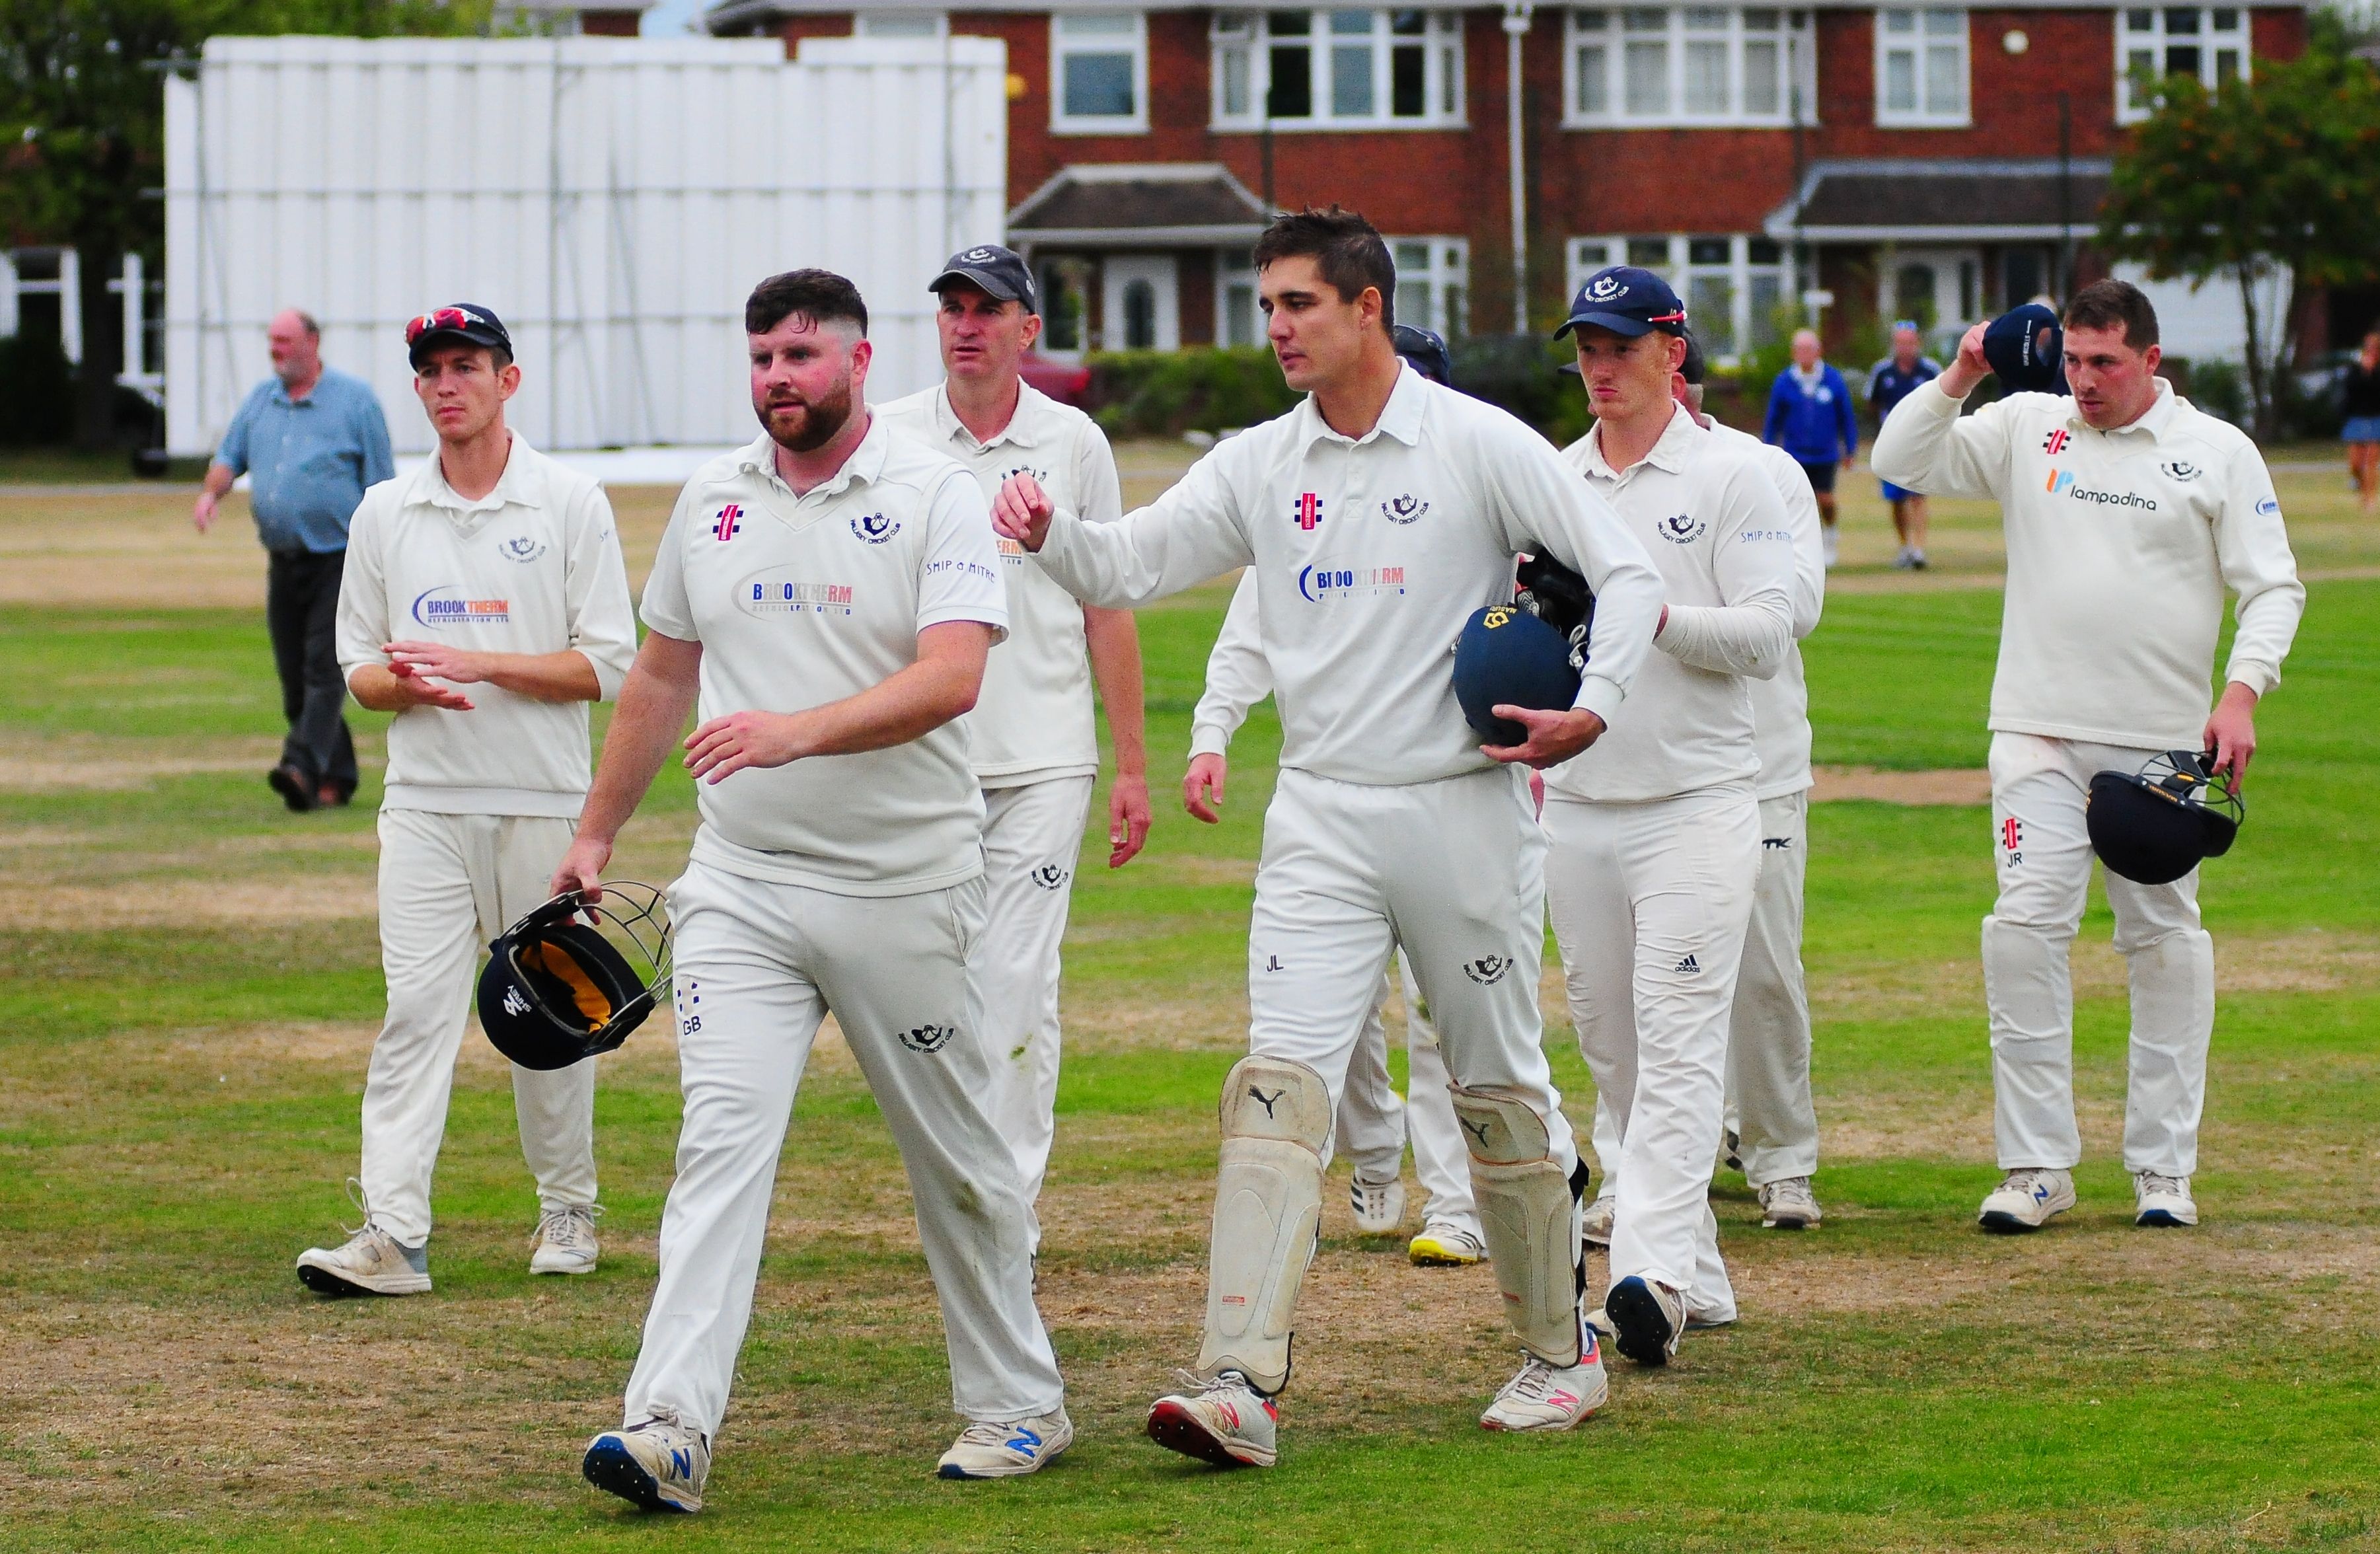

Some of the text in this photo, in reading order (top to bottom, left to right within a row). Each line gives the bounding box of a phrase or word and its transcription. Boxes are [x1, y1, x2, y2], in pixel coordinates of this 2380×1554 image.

[1594, 293, 1618, 303] CRICKET
[2070, 485, 2157, 511] lampadina
[1399, 513, 1420, 525] CRICKET
[1419, 502, 1429, 515] CLUB
[868, 534, 891, 544] CRICKET
[890, 523, 901, 536] CLUB
[1675, 533, 1697, 544] CRICKET
[1696, 523, 1706, 536] CLUB
[1741, 531, 1763, 543] SHIP
[926, 560, 952, 575] SHIP
[2007, 852, 2023, 868] JR
[1267, 955, 1284, 972] JL
[1674, 965, 1701, 973] adidas
[1485, 971, 1505, 986] CRICKET
[507, 985, 532, 1012] SHREY
[683, 1016, 702, 1036] GB
